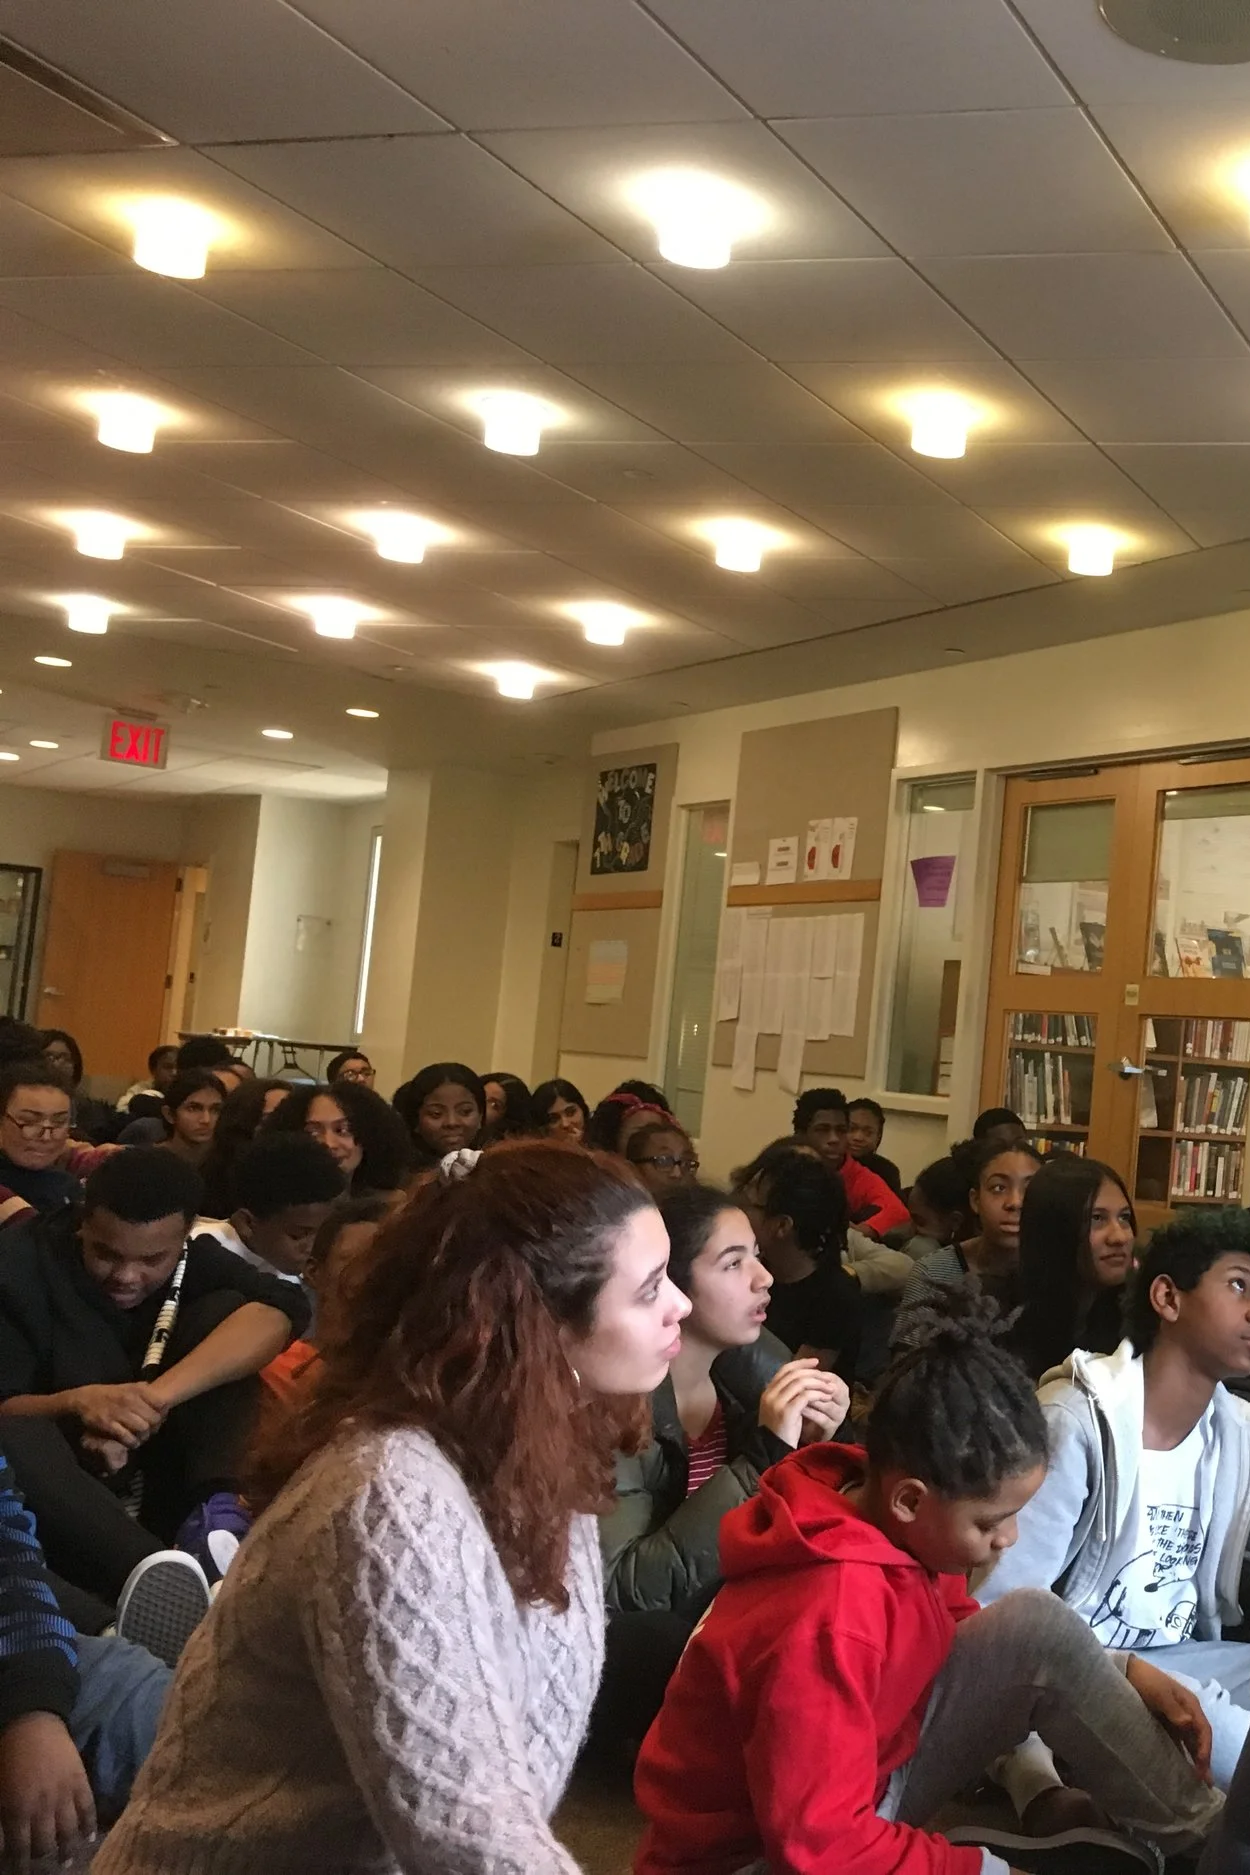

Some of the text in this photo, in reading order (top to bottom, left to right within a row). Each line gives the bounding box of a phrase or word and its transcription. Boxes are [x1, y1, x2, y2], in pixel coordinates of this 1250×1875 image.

[110, 720, 165, 765] EXIT
[596, 766, 656, 806] WELCOME
[1157, 1537, 1175, 1551] THE
